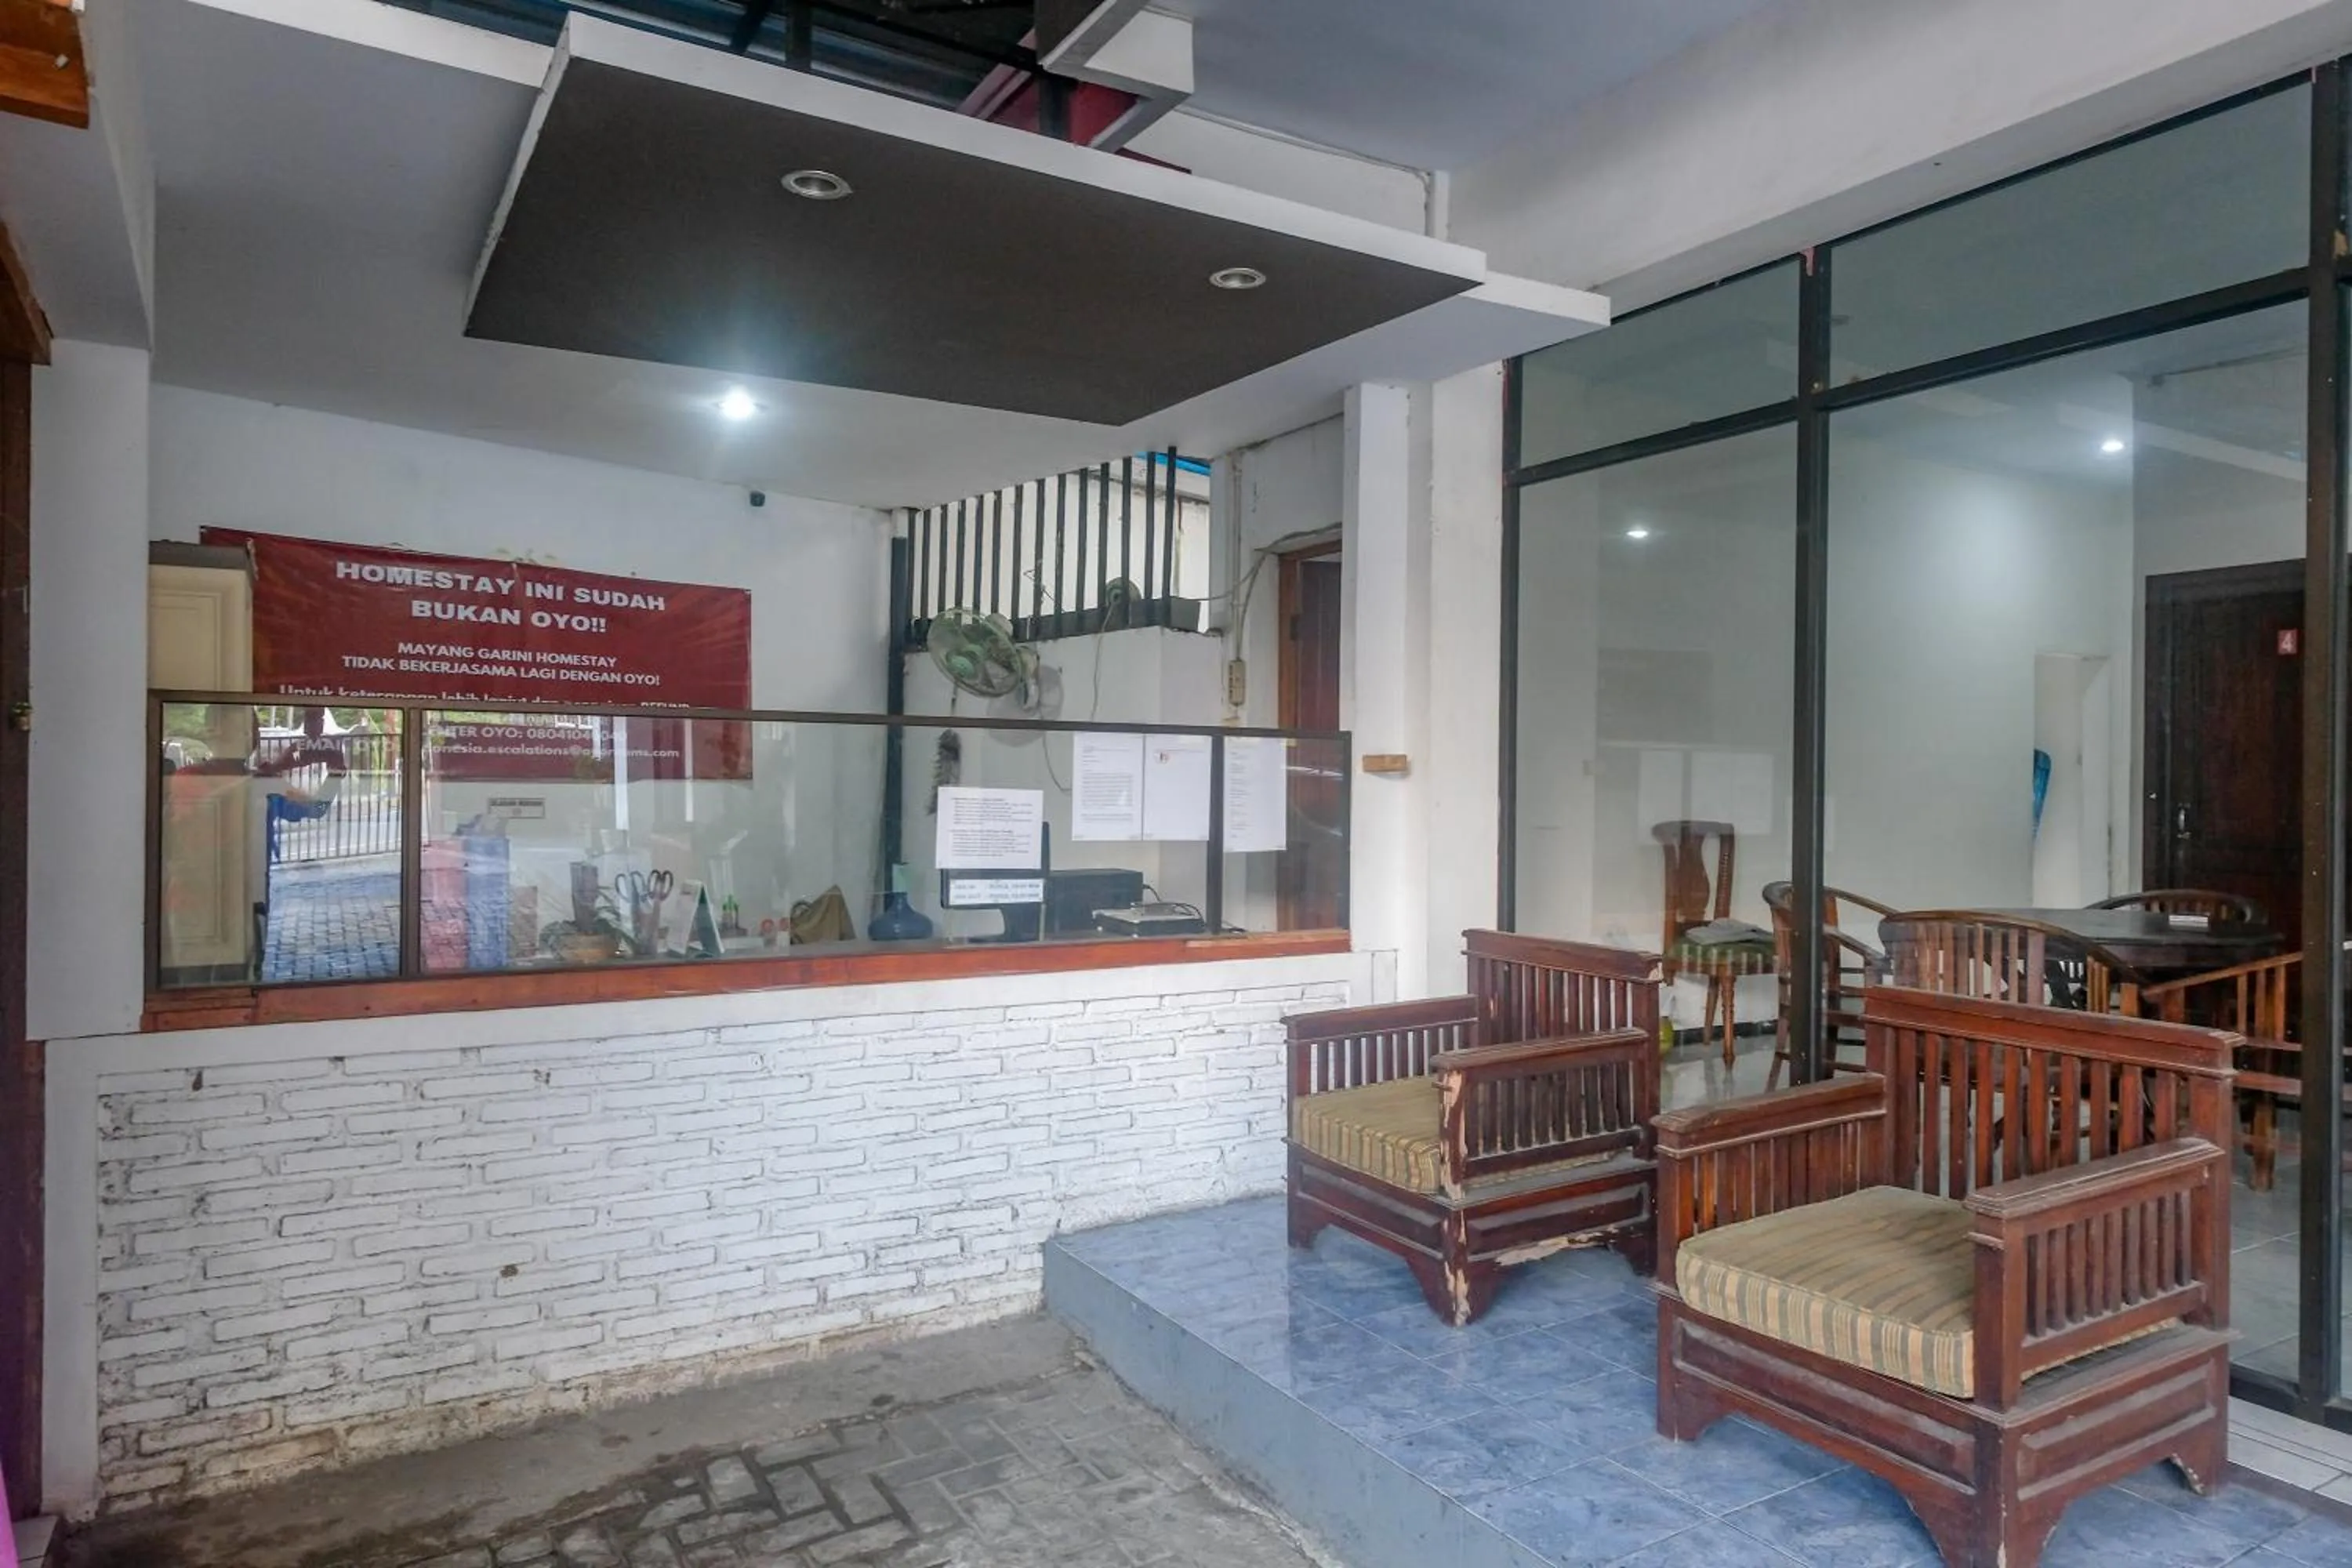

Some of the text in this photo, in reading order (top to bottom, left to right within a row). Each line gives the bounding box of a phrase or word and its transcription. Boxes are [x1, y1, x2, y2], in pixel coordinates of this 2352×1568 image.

[336, 561, 666, 611] HOMESTAY INI SUDAH
[411, 600, 606, 633] BUKAN OYO!!
[342, 655, 659, 686] TIDAK BEKERJASAMA LAGI DENGAN OYO!
[398, 642, 617, 667] MAYANG GARINI HOMESTAY
